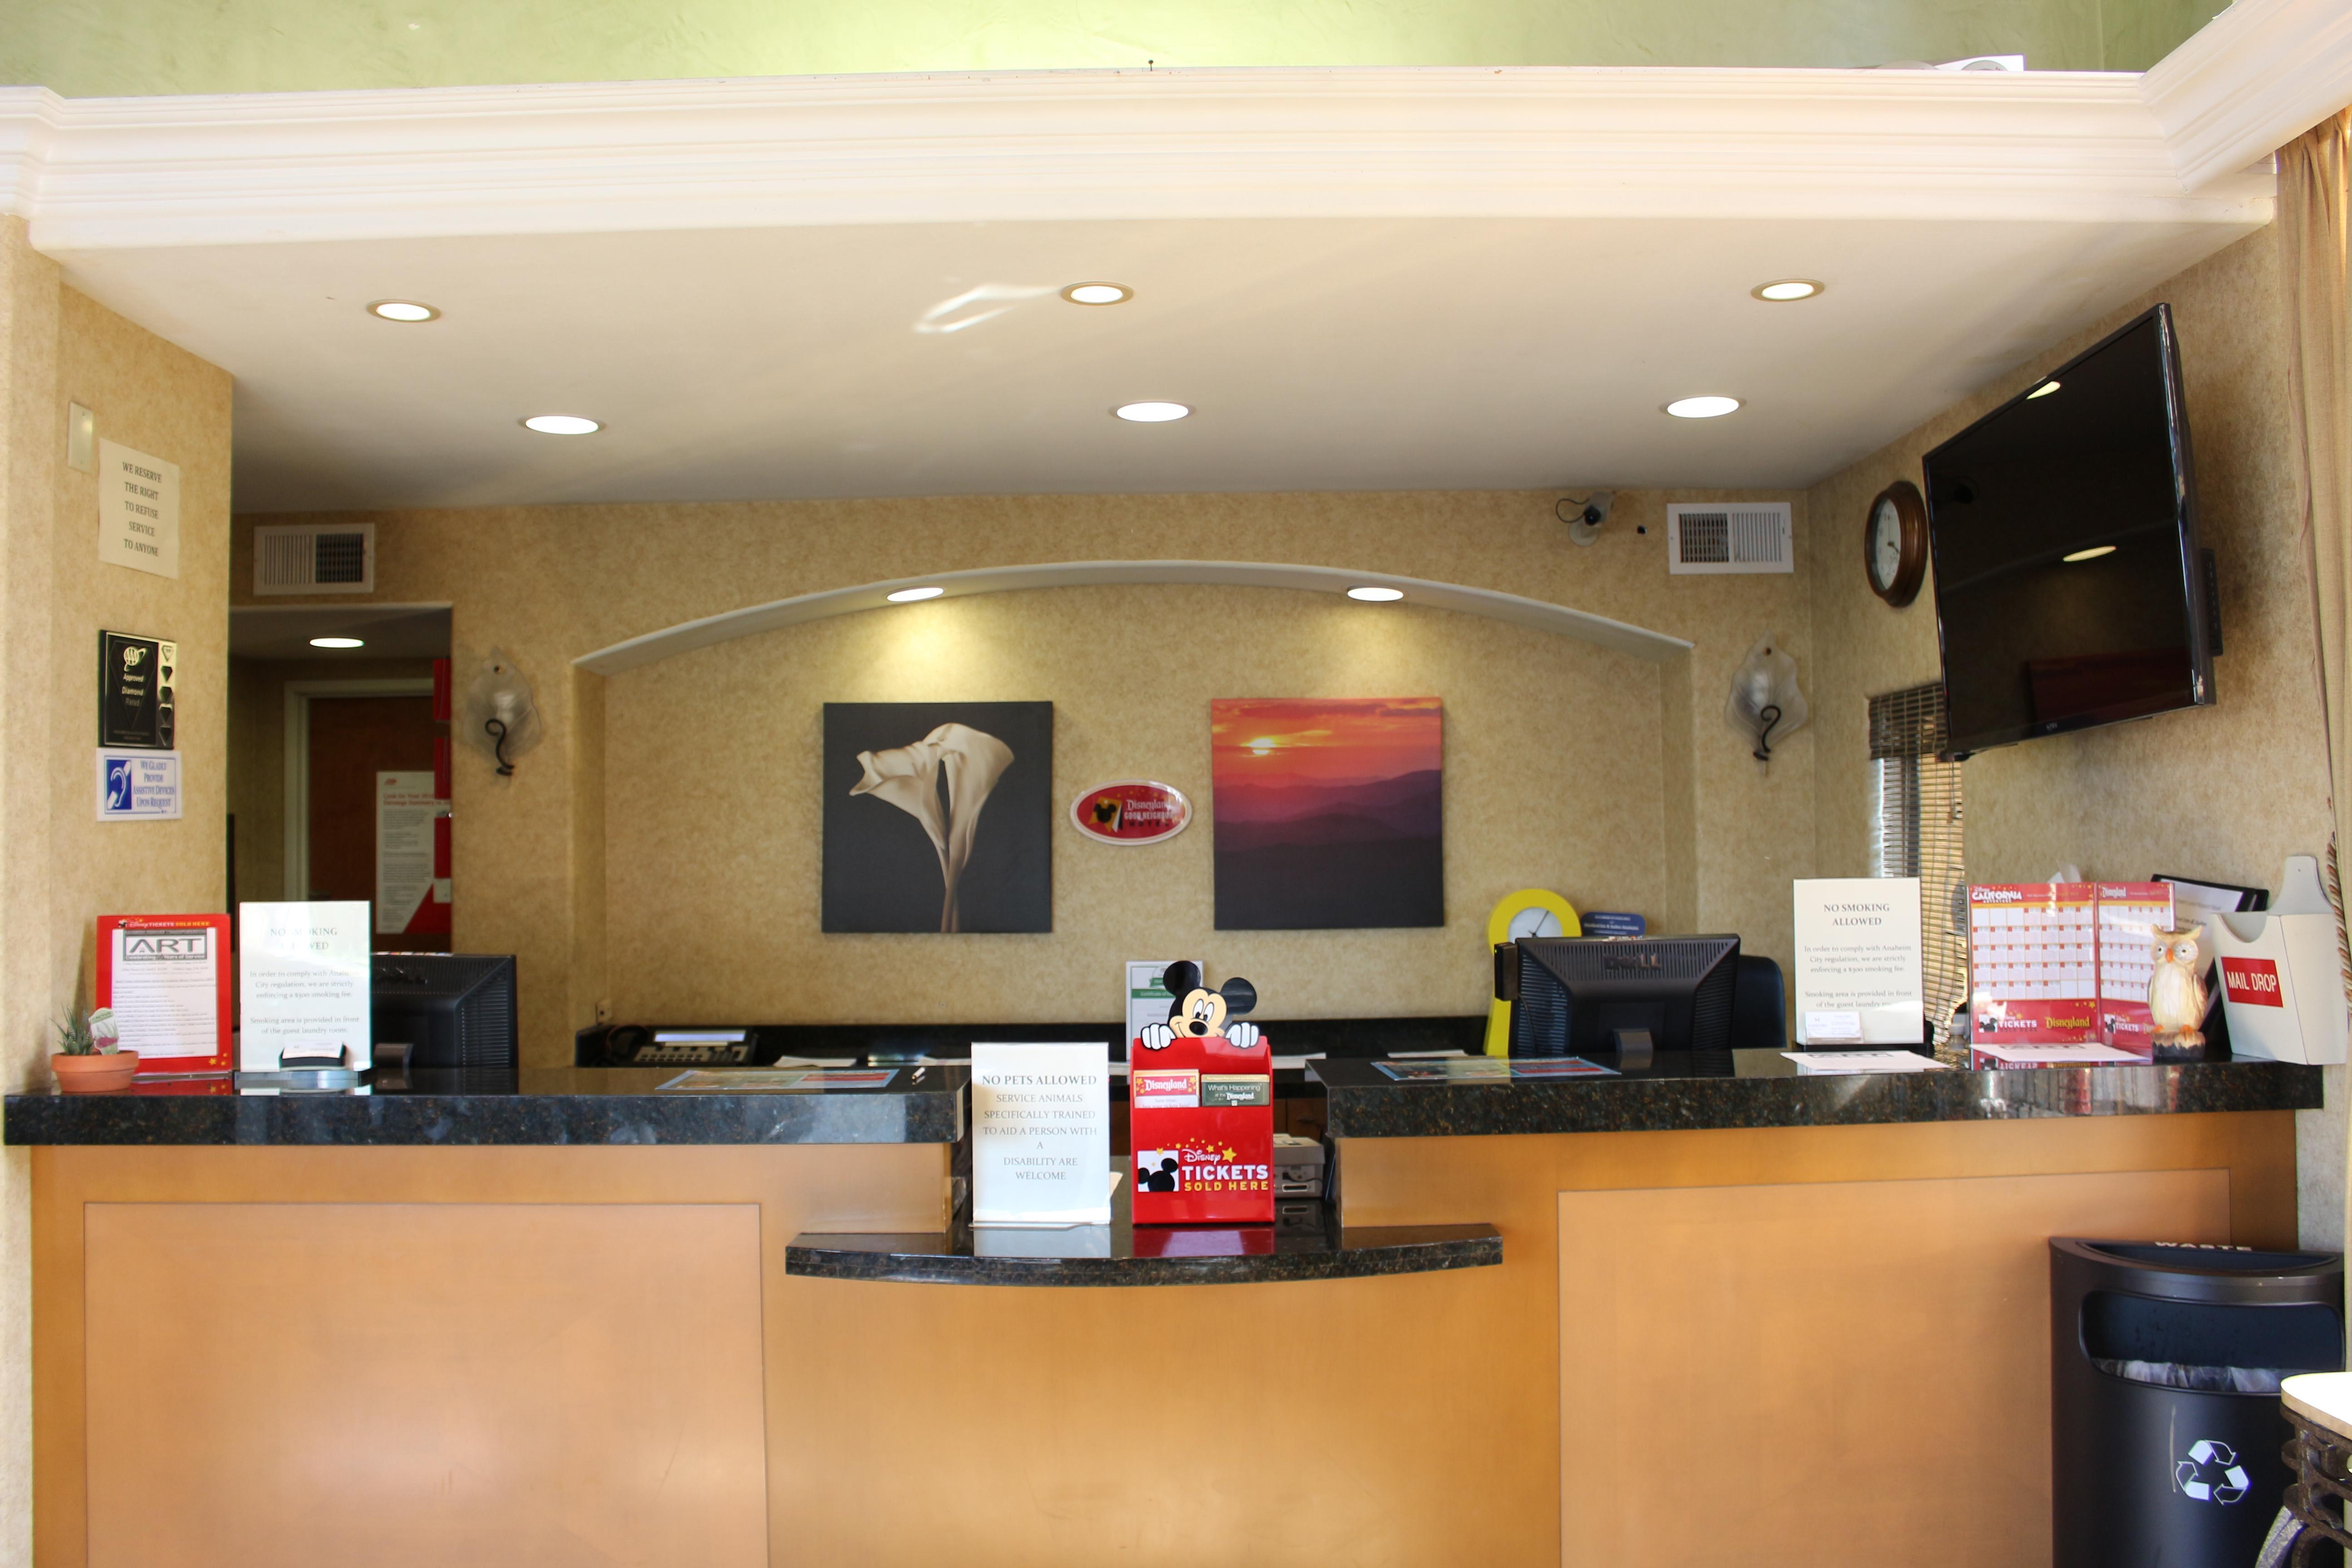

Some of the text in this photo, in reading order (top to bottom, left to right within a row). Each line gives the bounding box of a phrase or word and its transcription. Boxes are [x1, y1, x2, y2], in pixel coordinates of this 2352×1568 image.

[122, 462, 162, 484] WE RESERVE
[124, 482, 158, 500] THE RIGHT
[124, 501, 158, 519] TO REFUSE
[128, 521, 154, 537] SERVICE
[124, 539, 158, 557] TO ANYONE
[123, 673, 144, 682] Approved
[122, 687, 143, 696] Diamond
[148, 761, 167, 771] GLADLY
[144, 773, 163, 783] PROVIDE
[133, 785, 175, 795] ASSISTIVE DEVICES
[137, 797, 171, 808] UPON REQUEST
[1124, 812, 1142, 820] GOOD
[1972, 890, 2023, 901] CALIFORNIA
[1842, 903, 1890, 912] SMOKING
[1832, 917, 1882, 926] ALLOWED
[270, 928, 286, 937] NO
[129, 938, 202, 953] ART
[1809, 956, 1823, 964] City
[1825, 956, 1860, 964] regulation,
[286, 970, 311, 979] comply
[330, 980, 353, 988] strictly
[2226, 971, 2277, 992] MAIL DROP
[1805, 991, 1834, 999] Smoking
[1857, 990, 1886, 999] provided
[1999, 1019, 2038, 1029] TICKETS
[2044, 1015, 2090, 1029] Disneyland
[302, 1027, 327, 1035] laundry
[2116, 1023, 2139, 1032] TICKETS
[982, 1075, 1097, 1085] NO PETS ALLOWED
[1144, 1078, 1187, 1092] Disneyland
[1229, 1084, 1261, 1092] Happening
[996, 1094, 1083, 1102] SERVICE ANIMALS
[1226, 1093, 1255, 1101] Disneyland
[984, 1111, 1095, 1119] SPECIFICALLY TRAINED
[983, 1127, 1097, 1135] TO AID A PERSON WITH
[1036, 1142, 1044, 1150] A
[1181, 1148, 1220, 1165] Disney
[1004, 1157, 1078, 1166] DISABILITY ARE
[1015, 1171, 1066, 1180] WELCOME
[1181, 1164, 1269, 1181] TICKETS
[1184, 1181, 1269, 1191] SOLD HERE
